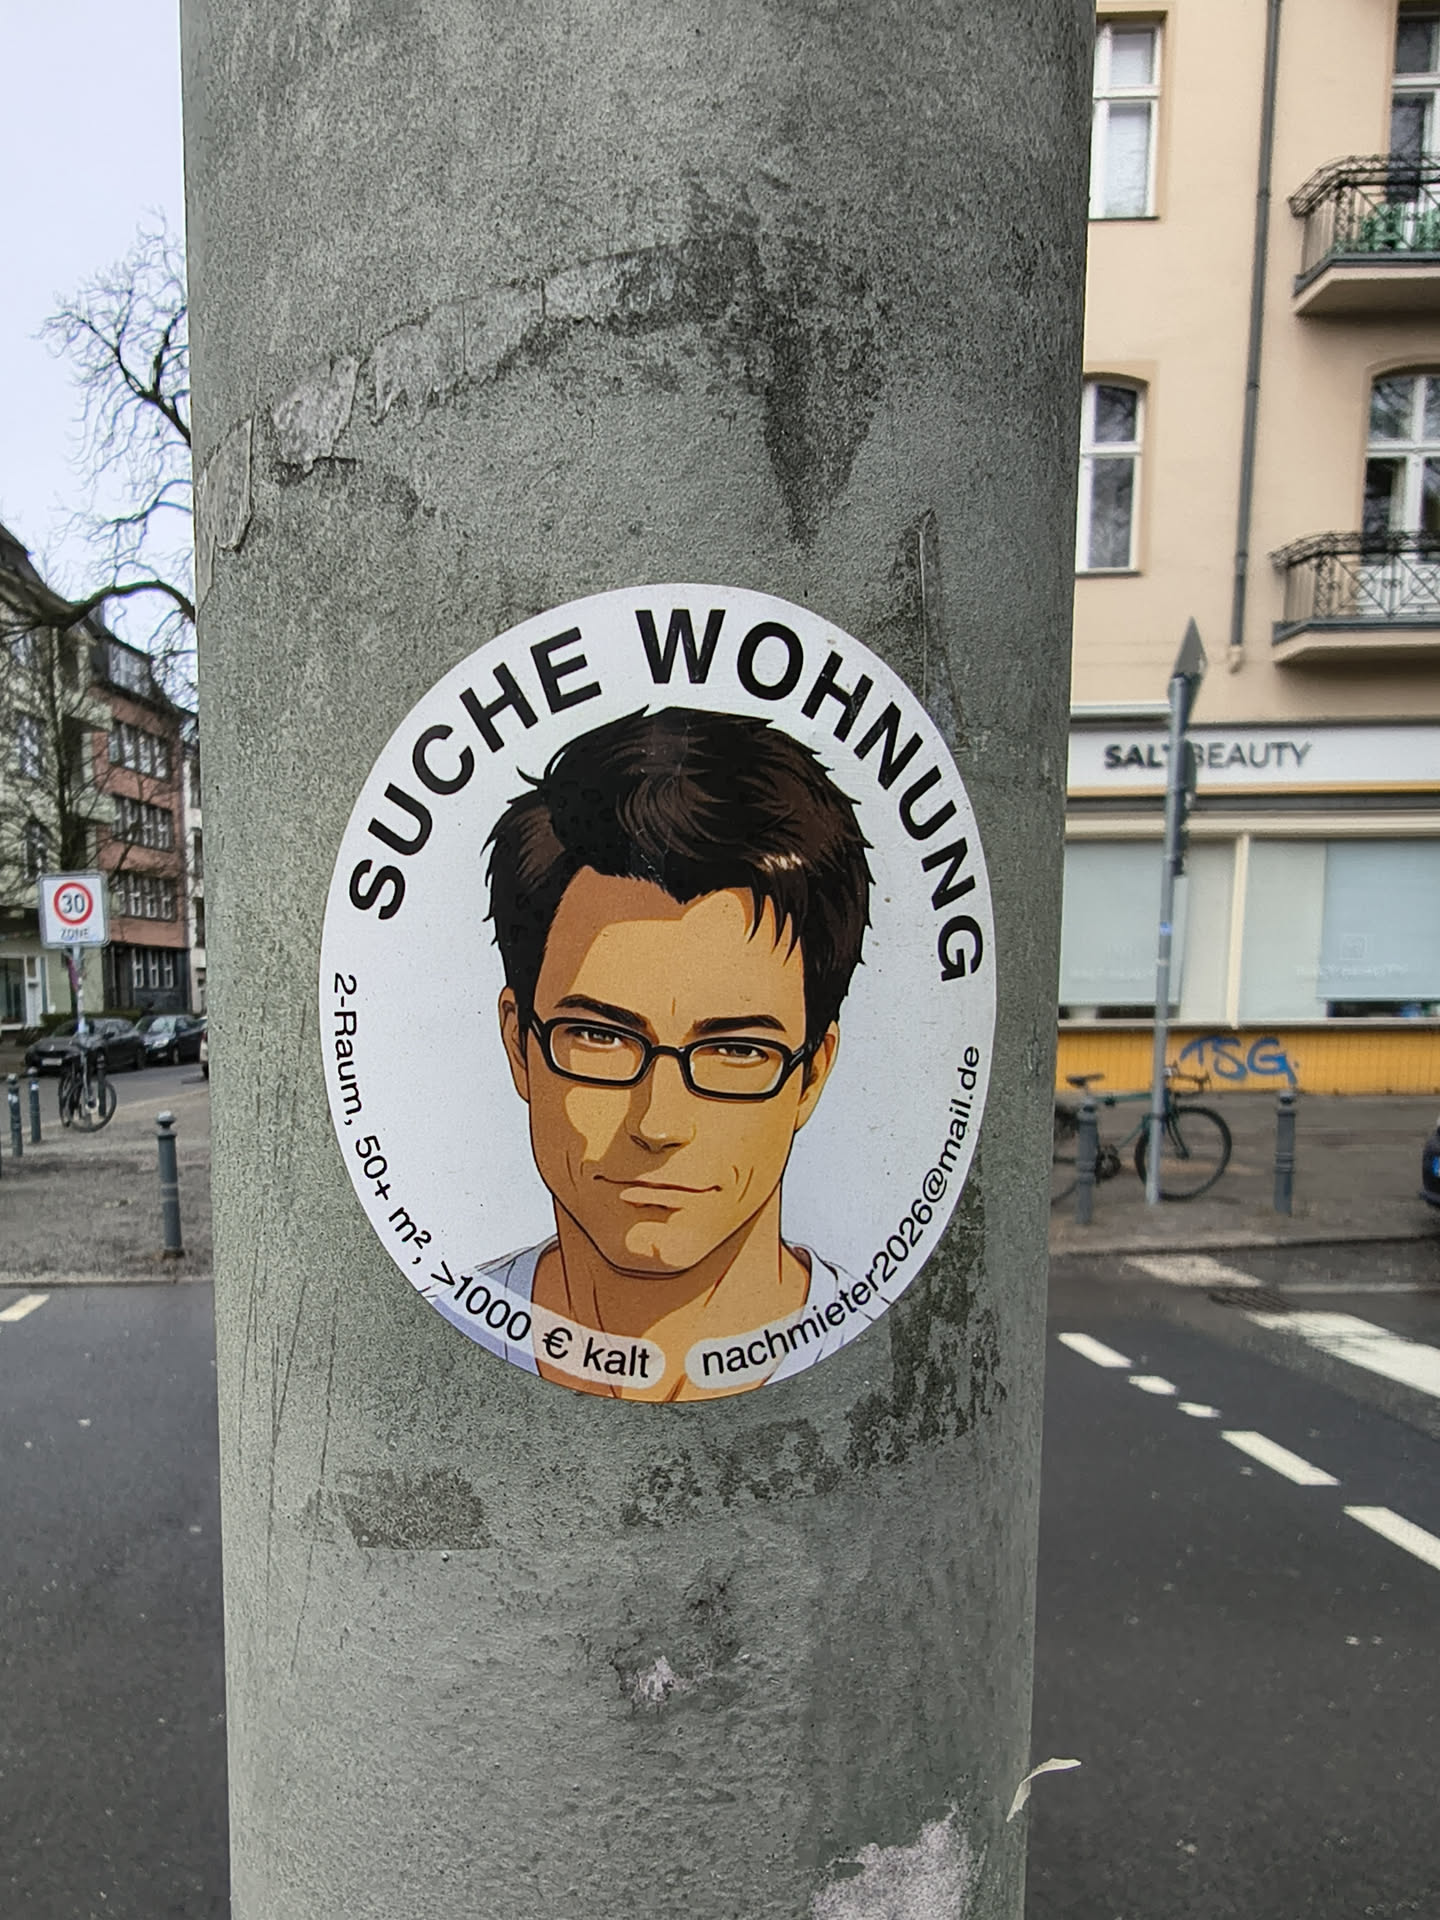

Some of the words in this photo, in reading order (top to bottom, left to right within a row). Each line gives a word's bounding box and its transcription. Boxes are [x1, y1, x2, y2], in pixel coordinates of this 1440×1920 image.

[61, 928, 89, 940] ZONE
[62, 893, 85, 914] 30
[348, 626, 602, 920] SUCHE
[635, 608, 984, 982] WOHNUNG
[333, 972, 363, 1126] 2-Raum,
[355, 1135, 391, 1201] 50+
[388, 1206, 432, 1265] m²,
[430, 1260, 533, 1342] >1000
[542, 1327, 573, 1360] €
[582, 1336, 651, 1378] kalt
[702, 1045, 980, 1376] nachmieter2026@mail.de
